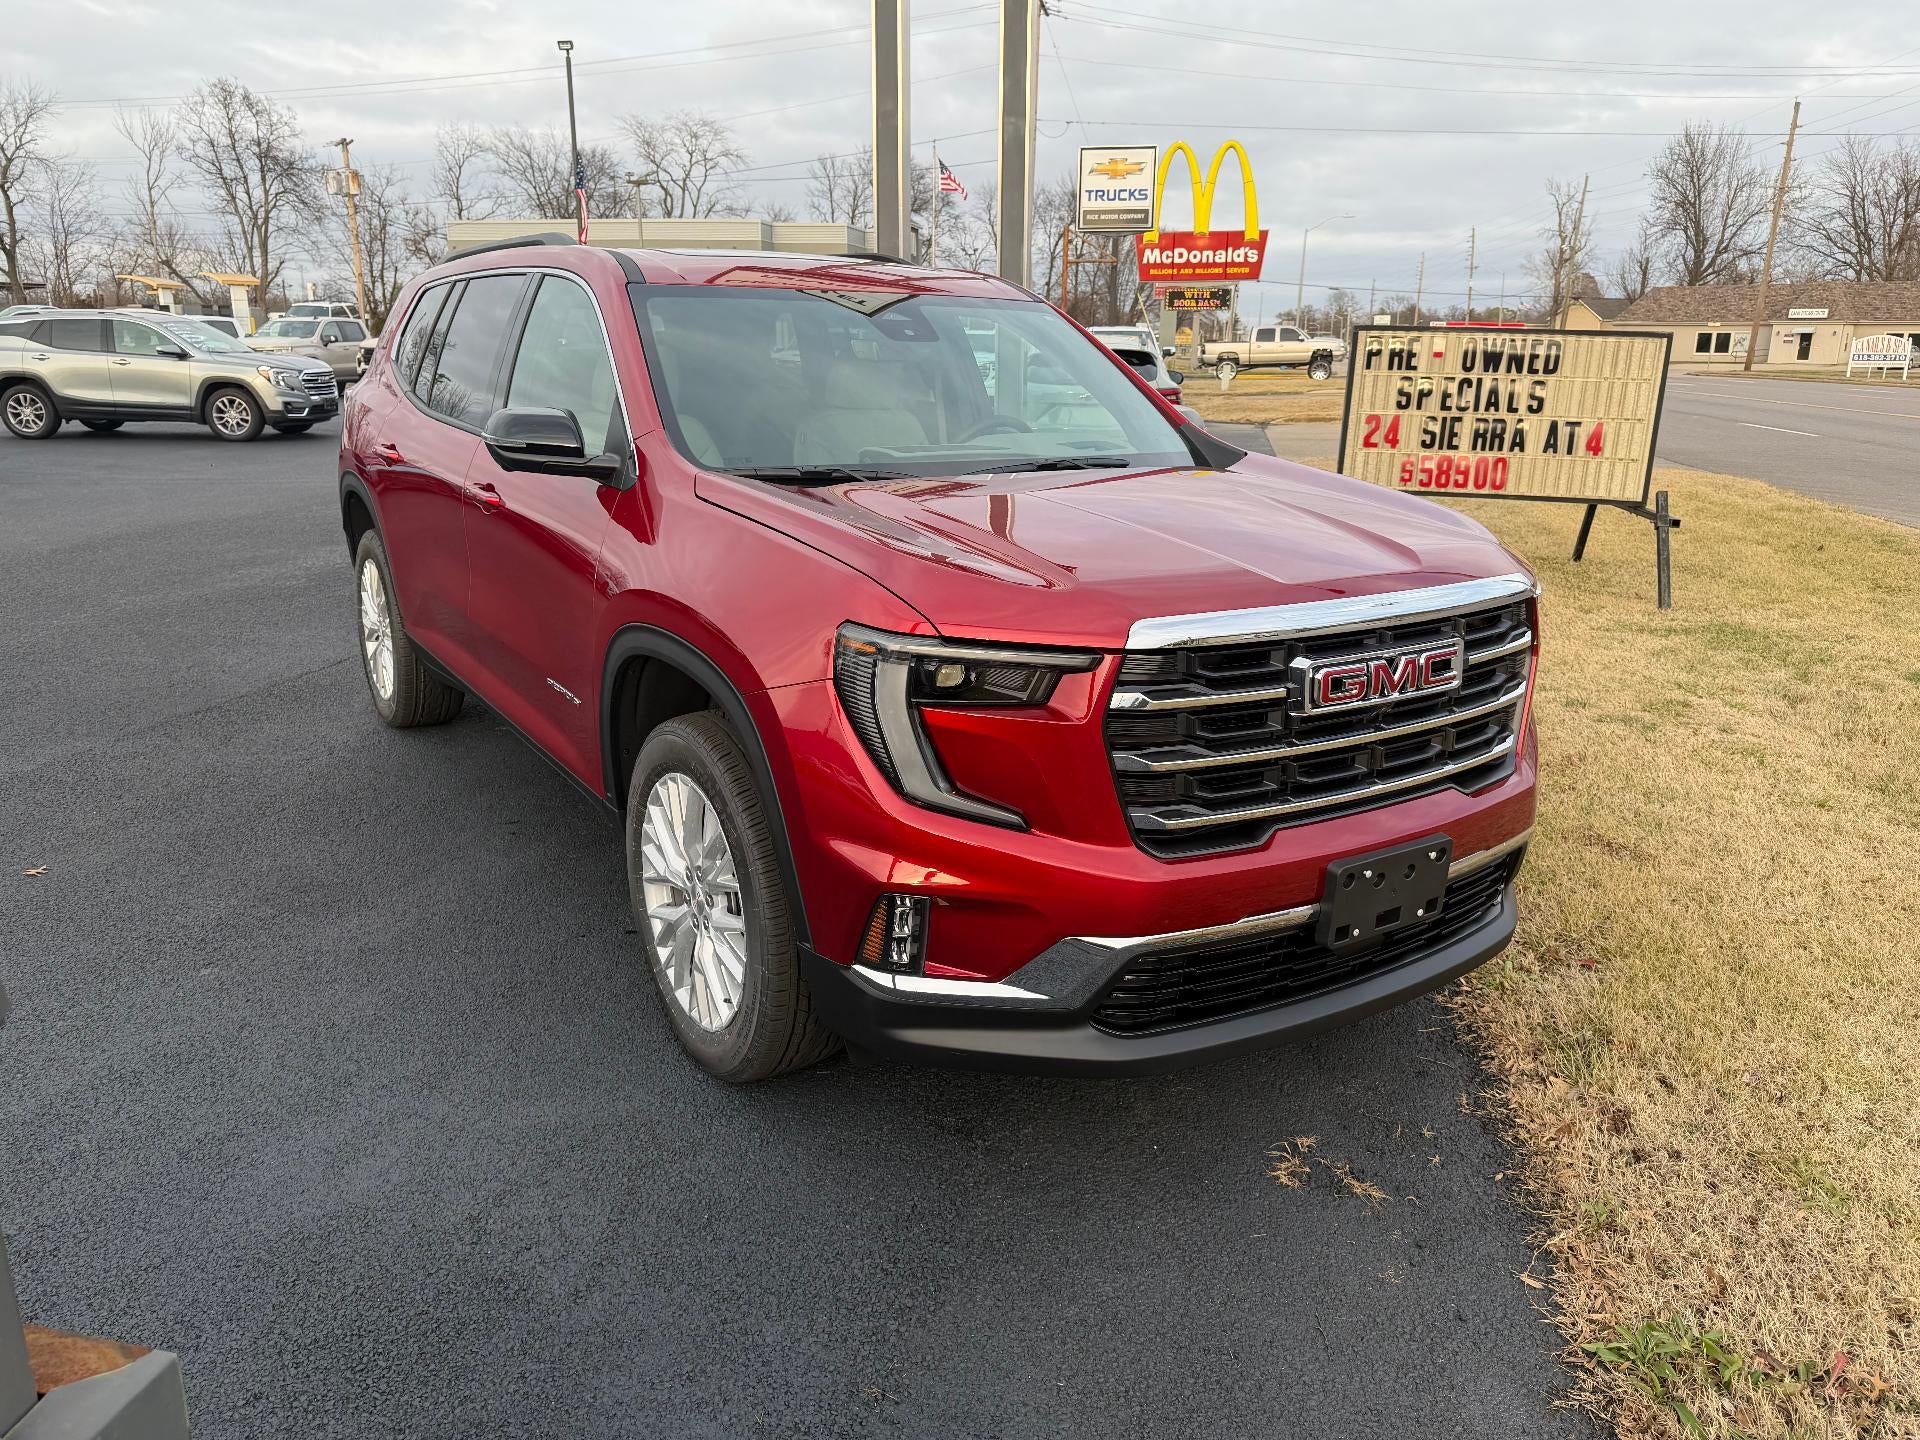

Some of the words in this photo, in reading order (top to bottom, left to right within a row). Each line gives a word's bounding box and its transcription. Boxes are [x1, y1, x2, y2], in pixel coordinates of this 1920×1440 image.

[1085, 188, 1149, 202] TRUCKS
[1142, 247, 1259, 264] McDonald's
[1150, 267, 1178, 275] BILLIONS
[1184, 291, 1211, 299] WITH
[1365, 336, 1421, 371] PRE
[1461, 337, 1562, 375] OWNED
[1396, 376, 1547, 414] SPECIALS
[1362, 414, 1401, 449] 24
[1421, 415, 1525, 453] SIERRA
[1542, 420, 1582, 456] AT
[1585, 421, 1604, 457] 4
[1399, 454, 1508, 491] $58900
[1313, 646, 1460, 706] GMC
